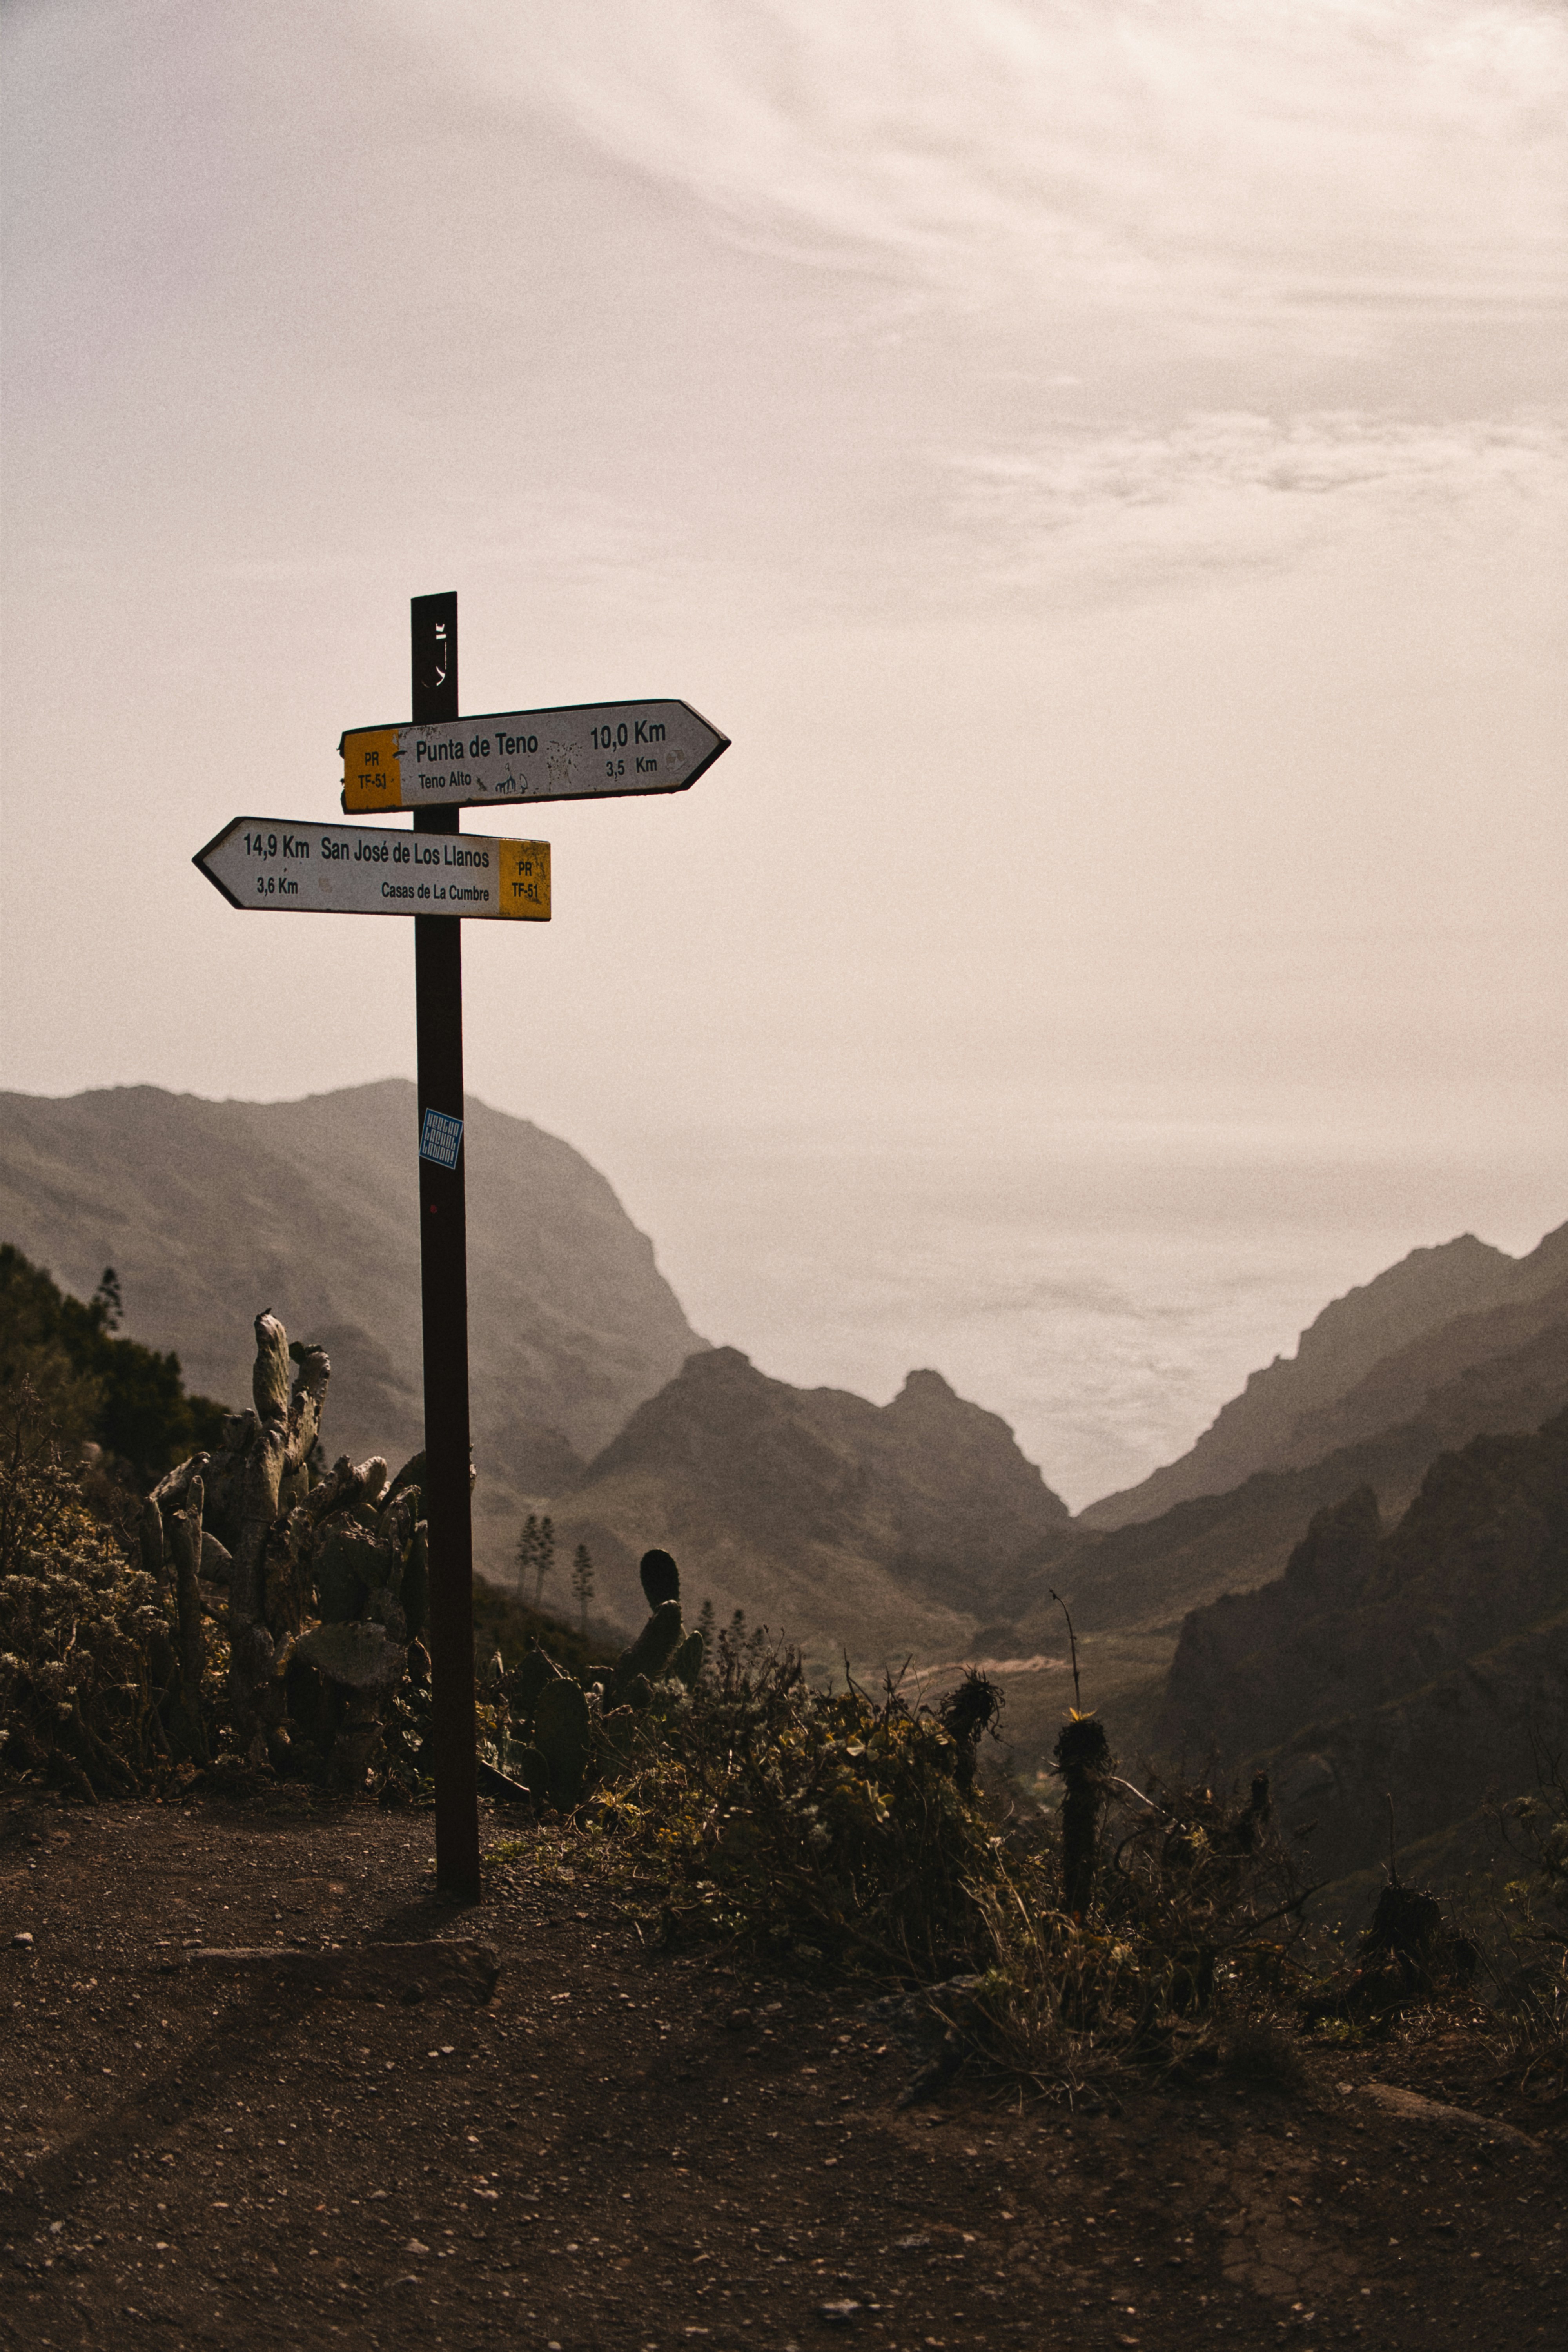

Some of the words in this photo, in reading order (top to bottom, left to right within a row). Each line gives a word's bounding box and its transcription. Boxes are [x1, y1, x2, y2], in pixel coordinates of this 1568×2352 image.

[416, 739, 465, 763] Punta
[469, 735, 490, 758] de
[495, 732, 538, 755] Teno
[590, 723, 628, 752] 10,0
[635, 720, 666, 744] Km
[365, 751, 379, 766] PR
[358, 773, 386, 789] TF-51
[418, 774, 445, 789] Teno
[449, 771, 472, 787] Alto
[606, 760, 625, 779] 3,5
[636, 757, 657, 773] Km
[244, 833, 277, 861] 14,9
[283, 835, 309, 858] Km
[321, 837, 349, 860] San
[354, 840, 389, 862] José
[393, 842, 410, 863] de
[414, 843, 440, 865] Los
[444, 845, 489, 868] Llanos
[517, 861, 532, 876] PR
[257, 877, 275, 897] 3,6
[279, 877, 298, 894] Km
[381, 882, 414, 898] Casas
[417, 883, 430, 899] de
[434, 884, 446, 900] La
[449, 885, 489, 902] Cumbre
[512, 882, 538, 899] TF-51
